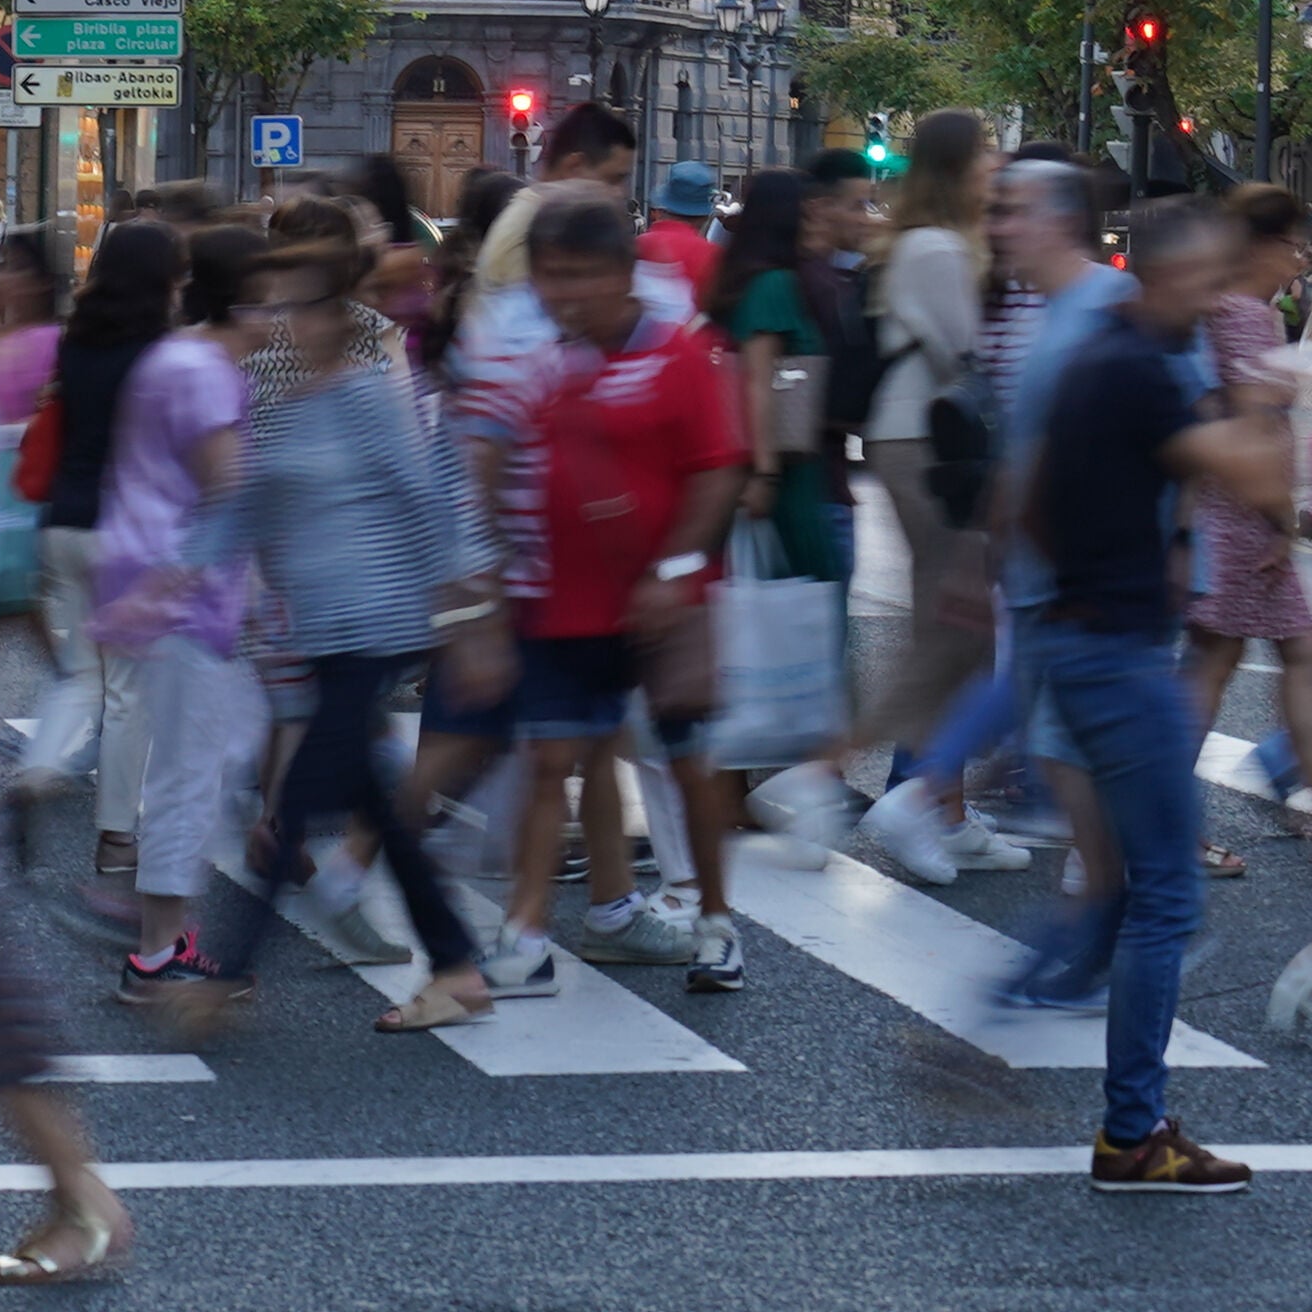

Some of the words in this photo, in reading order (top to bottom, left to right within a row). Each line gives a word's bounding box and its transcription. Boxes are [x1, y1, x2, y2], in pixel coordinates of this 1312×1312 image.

[73, 22, 126, 35] Biribila
[136, 22, 175, 37] plaza
[67, 38, 105, 52] plaza
[115, 38, 176, 50] Circular
[64, 71, 174, 83] Bilbao-Abando
[432, 79, 446, 92] 11
[113, 85, 173, 101] geltokia
